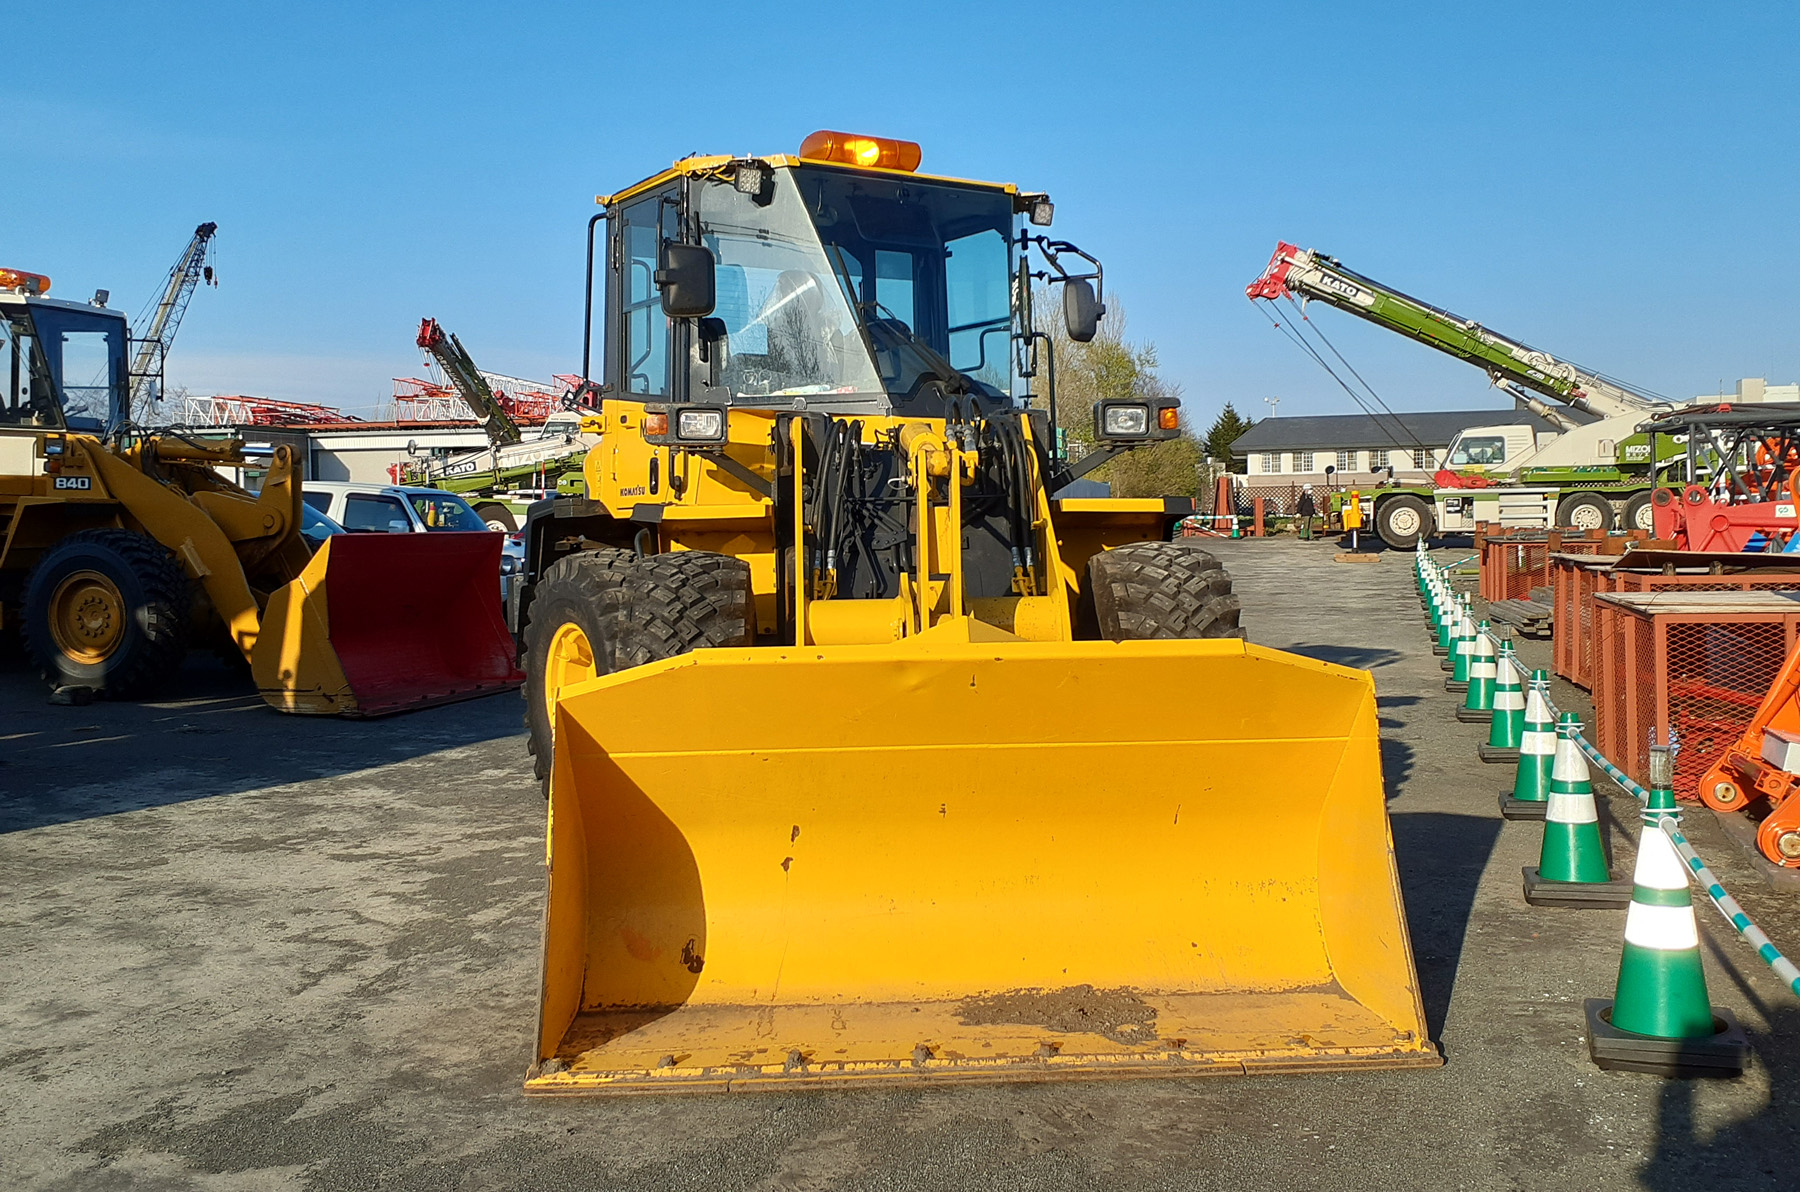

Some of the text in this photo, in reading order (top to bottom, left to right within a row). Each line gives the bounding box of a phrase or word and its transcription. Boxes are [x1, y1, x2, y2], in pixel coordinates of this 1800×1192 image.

[1321, 276, 1357, 295] KATO
[1625, 445, 1650, 454] MIZO
[445, 462, 475, 475] KATO
[55, 478, 89, 489] 840
[619, 485, 646, 497] KOMATSU
